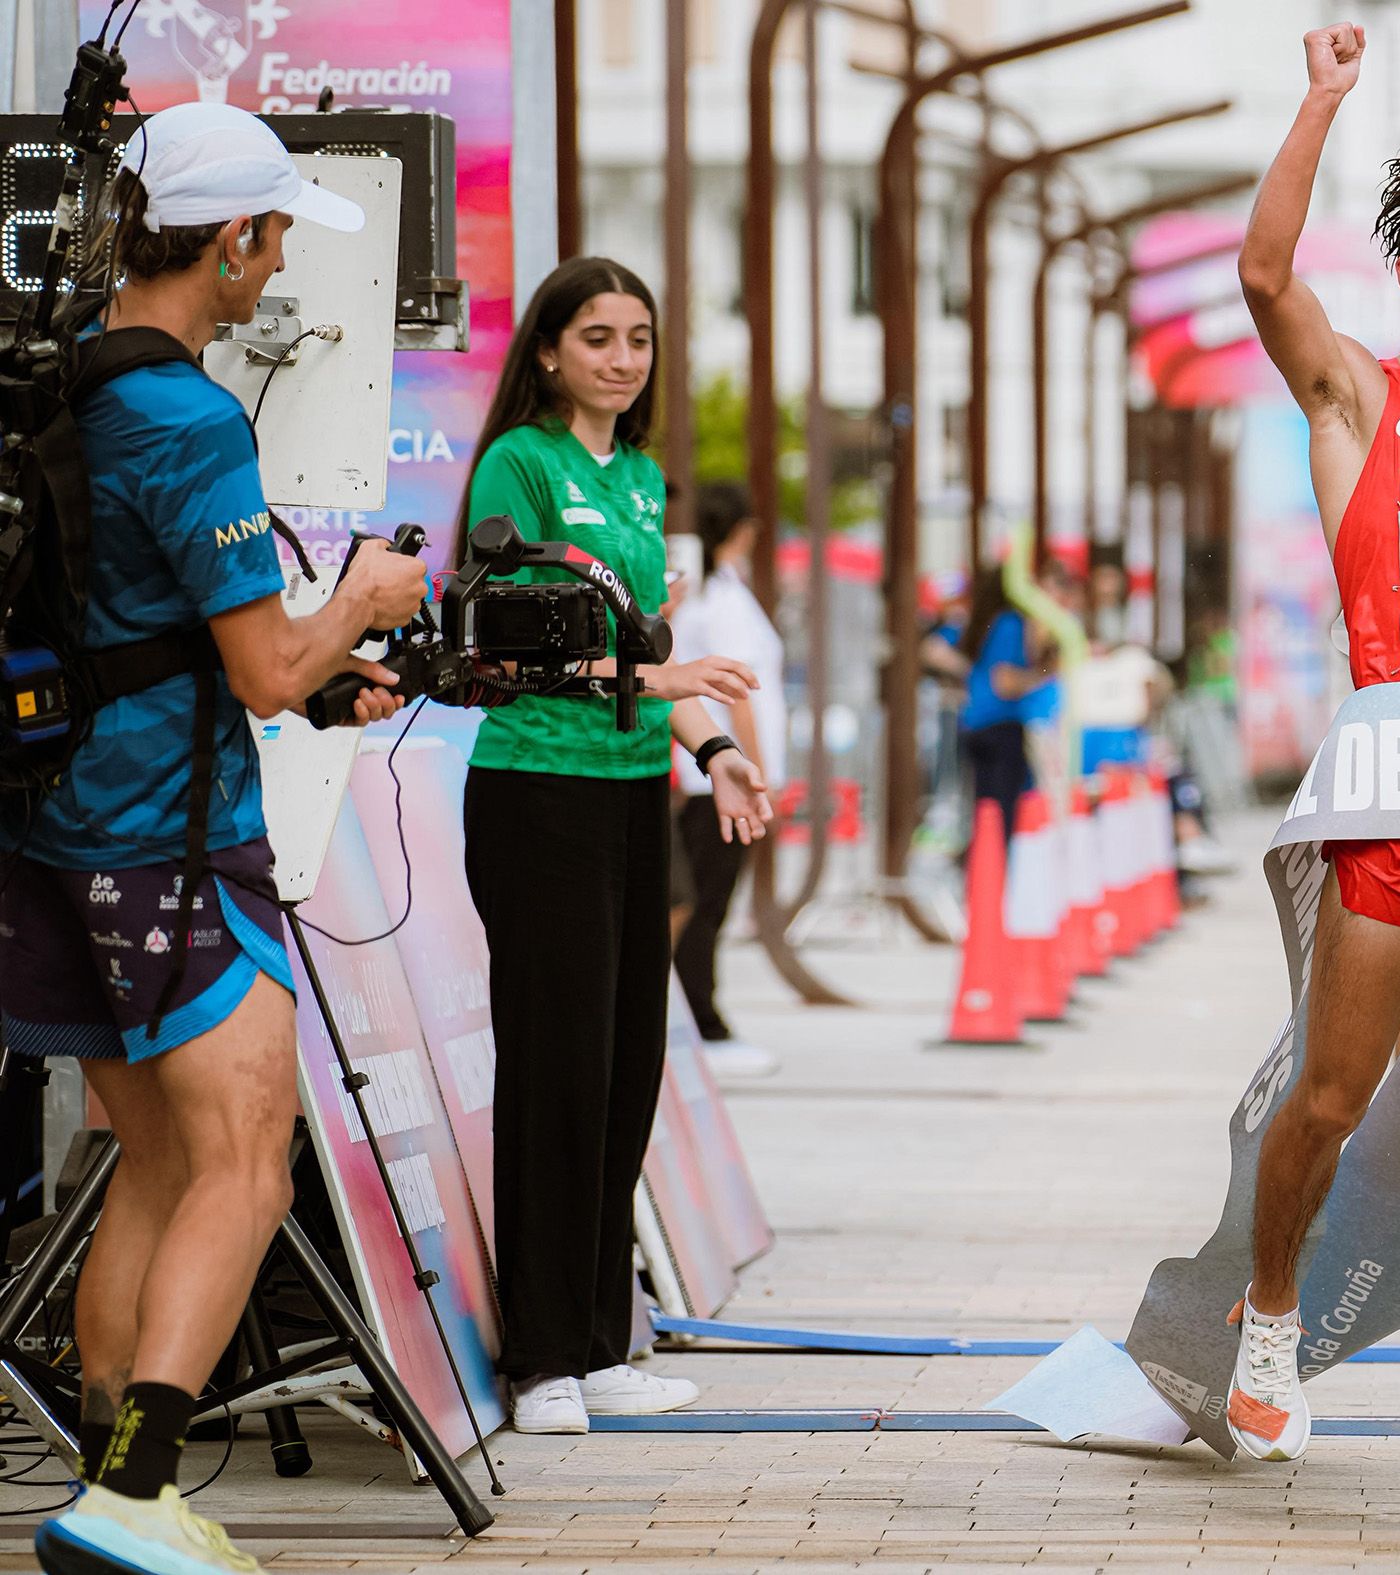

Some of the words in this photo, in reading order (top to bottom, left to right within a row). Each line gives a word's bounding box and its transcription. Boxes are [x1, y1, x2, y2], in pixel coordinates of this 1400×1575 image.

[258, 52, 451, 96] Federación
[589, 561, 632, 612] RONIN
[1321, 1258, 1385, 1336] Coruña
[1304, 1338, 1342, 1361] da
